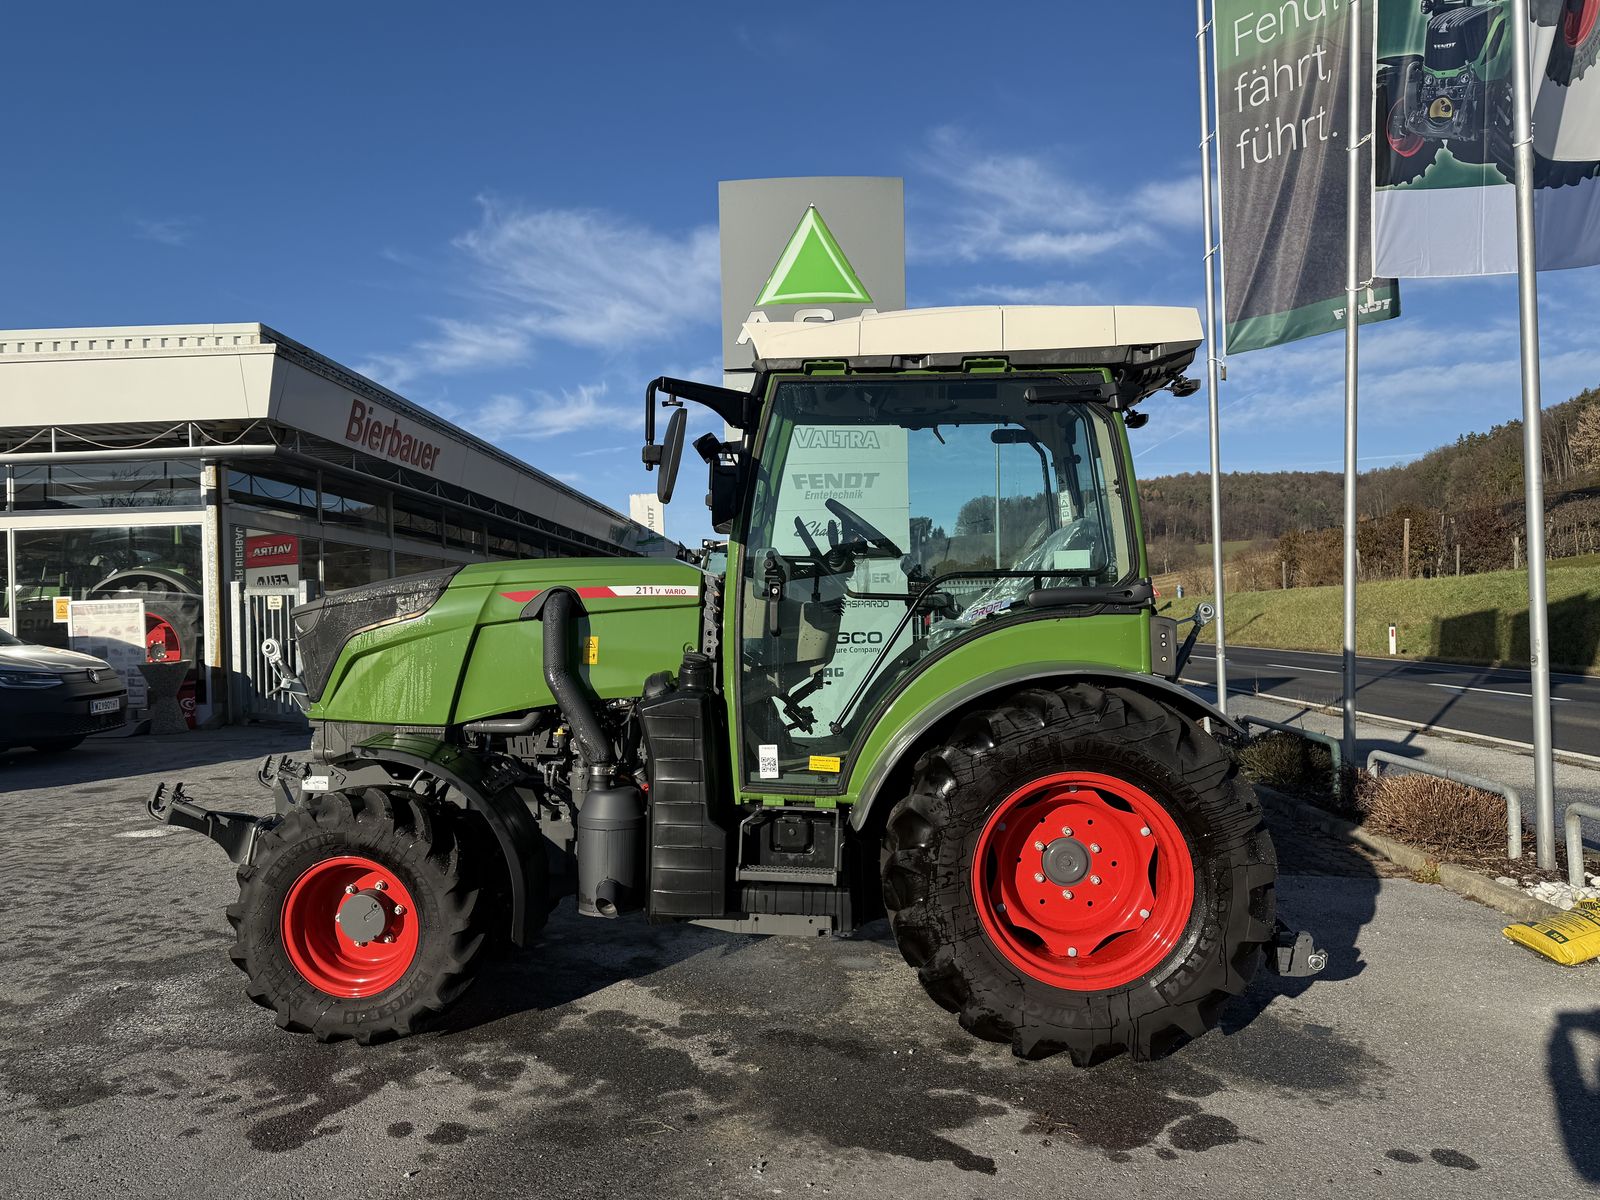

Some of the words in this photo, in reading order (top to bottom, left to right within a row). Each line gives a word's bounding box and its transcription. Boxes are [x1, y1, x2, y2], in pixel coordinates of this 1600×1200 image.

[1234, 44, 1331, 113] fährt,
[1236, 105, 1338, 169] führt.
[345, 399, 441, 471] Bierbauer
[793, 427, 881, 450] VALTRA
[792, 472, 880, 489] FENDT
[805, 489, 864, 500] Erntetechnik
[844, 600, 889, 608] ASPARDO
[837, 631, 883, 644] GCO
[849, 646, 881, 655] Company
